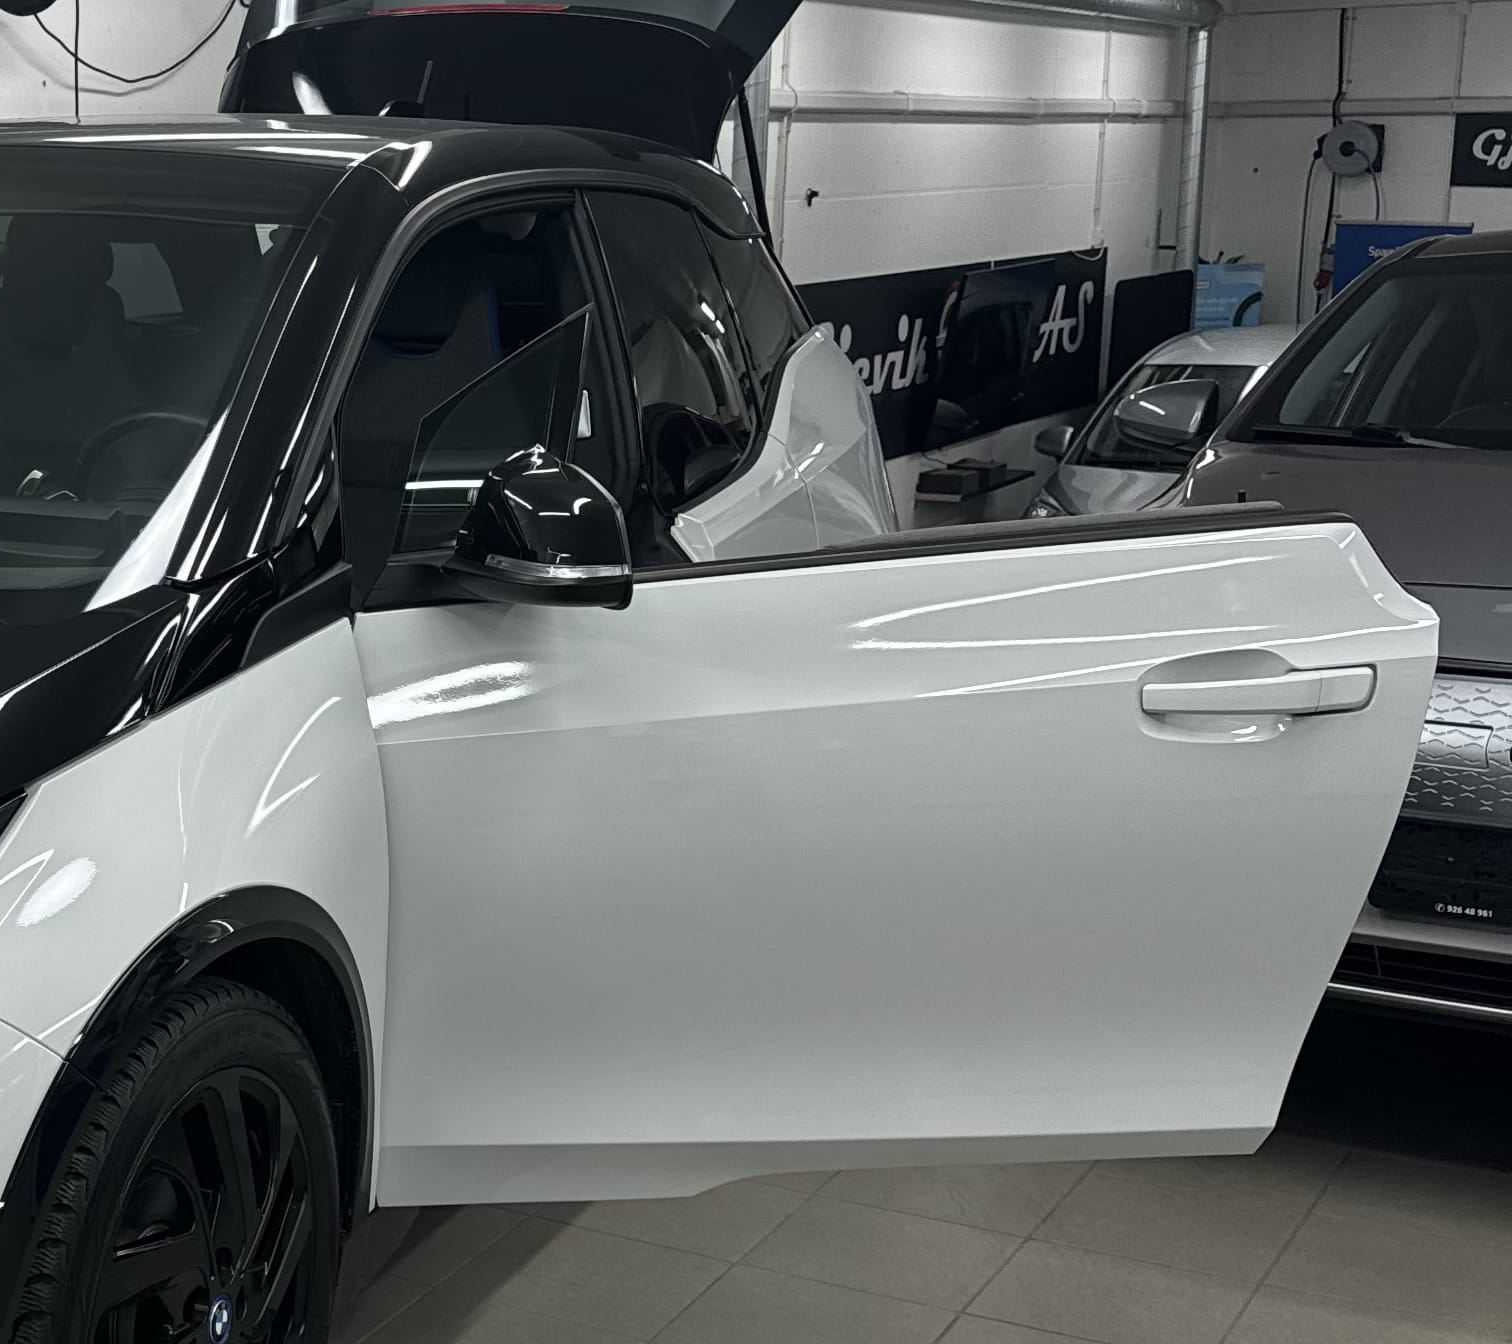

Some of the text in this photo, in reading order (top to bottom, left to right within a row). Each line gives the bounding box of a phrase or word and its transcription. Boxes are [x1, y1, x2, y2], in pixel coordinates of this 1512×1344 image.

[1032, 280, 1094, 363] AS
[1447, 904, 1463, 914] 926
[1477, 908, 1493, 918] 961
